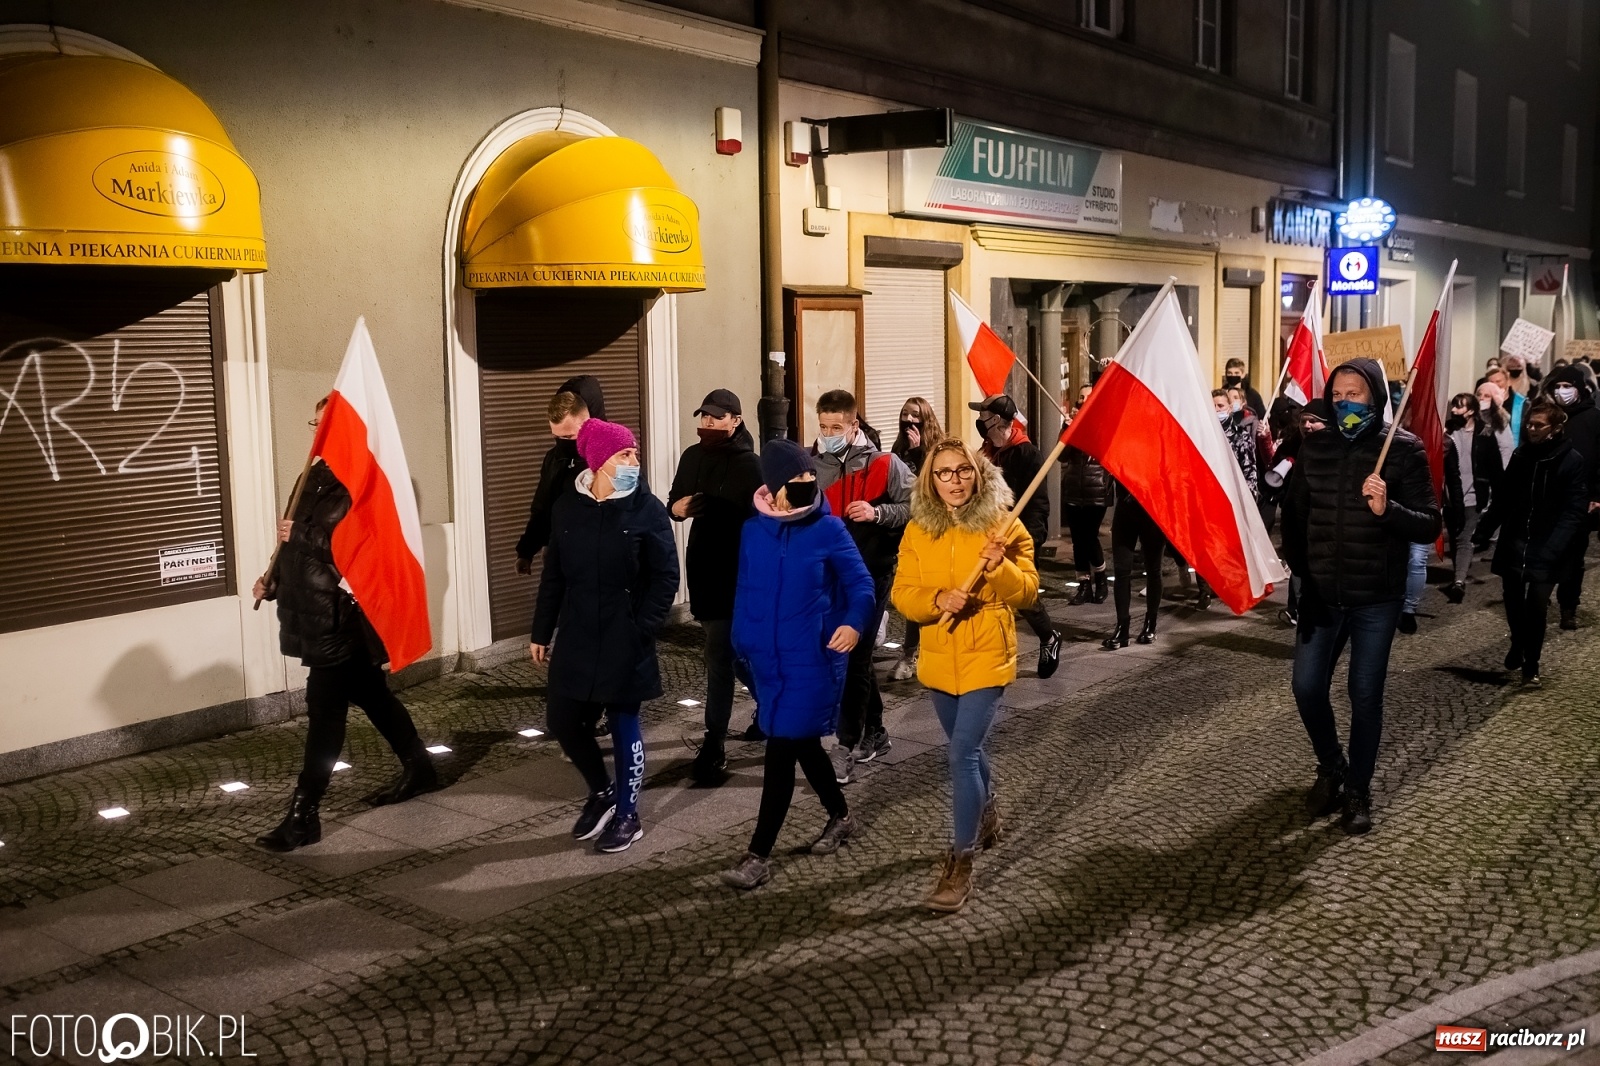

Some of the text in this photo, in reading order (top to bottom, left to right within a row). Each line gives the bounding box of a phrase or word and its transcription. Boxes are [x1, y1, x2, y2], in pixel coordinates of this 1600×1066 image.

[129, 162, 161, 174] Anida
[171, 164, 199, 181] Adam
[973, 137, 1074, 188] FUJIFILM
[111, 177, 217, 206] Markiewka
[951, 186, 1080, 215] LABORATORIUM FOTOGRAFICZNE
[1092, 186, 1115, 199] STUDIO
[665, 215, 681, 226] Adam
[1273, 201, 1332, 248] KANTOR
[634, 224, 689, 244] Markiewka
[69, 243, 170, 259] PIEKARNIA
[172, 244, 242, 261] CUKIERNIA
[469, 271, 529, 283] PIEKARNIA
[532, 270, 606, 282] CUKIERNIA
[610, 270, 668, 282] PIEKARNIA
[669, 272, 703, 283] CUKIERNIA
[1355, 339, 1402, 353] POLSKA
[163, 556, 213, 569] PARTNER
[629, 740, 645, 803] adidas
